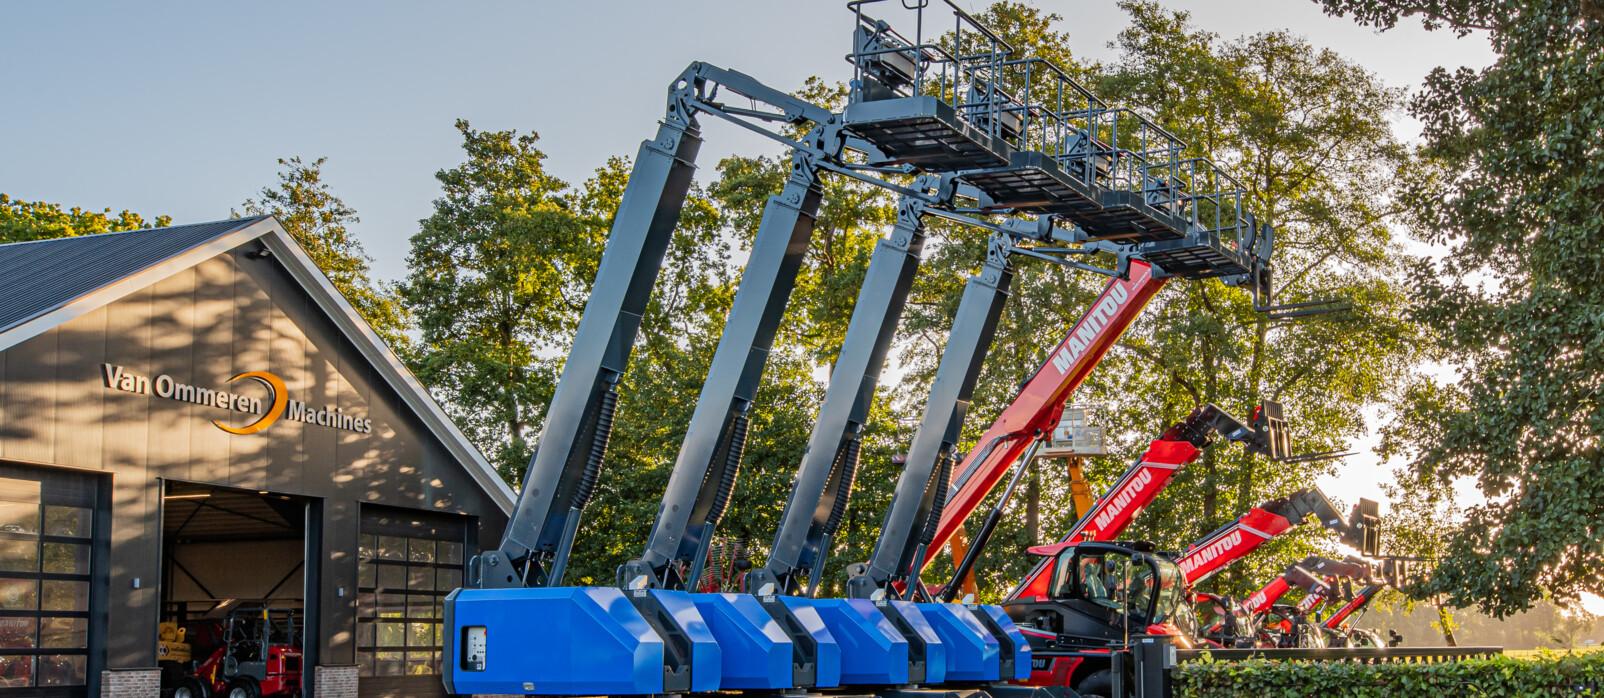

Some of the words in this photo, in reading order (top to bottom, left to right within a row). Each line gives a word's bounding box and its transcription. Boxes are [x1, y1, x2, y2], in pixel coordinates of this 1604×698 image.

[1052, 281, 1128, 375] MANITOU
[102, 363, 150, 394] Van
[153, 374, 263, 414] Ommeren
[287, 399, 372, 433] Machines
[1094, 467, 1152, 532] MANITOU
[1179, 530, 1242, 574] MANITOU
